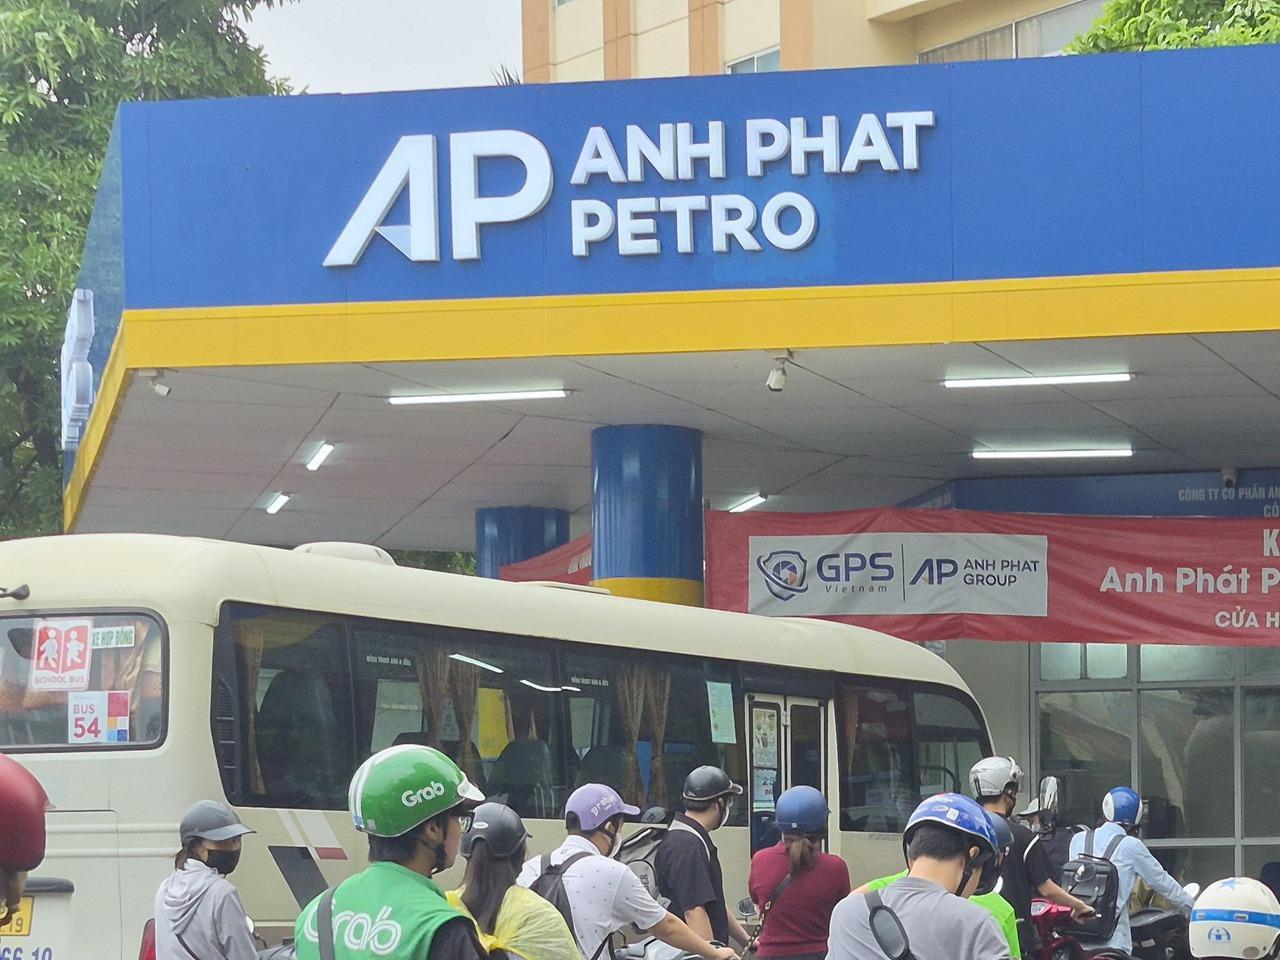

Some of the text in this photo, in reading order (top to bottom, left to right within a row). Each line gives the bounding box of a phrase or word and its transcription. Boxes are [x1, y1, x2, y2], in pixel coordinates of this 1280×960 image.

[570, 111, 935, 185] ANH PHAT
[322, 129, 554, 267] AP
[571, 192, 818, 257] PETRO
[816, 552, 894, 583] GPS
[908, 558, 959, 586] AP
[963, 558, 1040, 572] ANH PHAT
[825, 584, 888, 594] Vietnam
[963, 573, 1017, 586] GROUP
[1099, 566, 1164, 593] Anh
[1176, 564, 1250, 594] Phát
[1214, 605, 1260, 629] CỬA
[34, 675, 86, 685] SCHOOL BUS
[73, 704, 96, 714] BUS
[73, 717, 102, 738] 54
[401, 780, 445, 807] Grab
